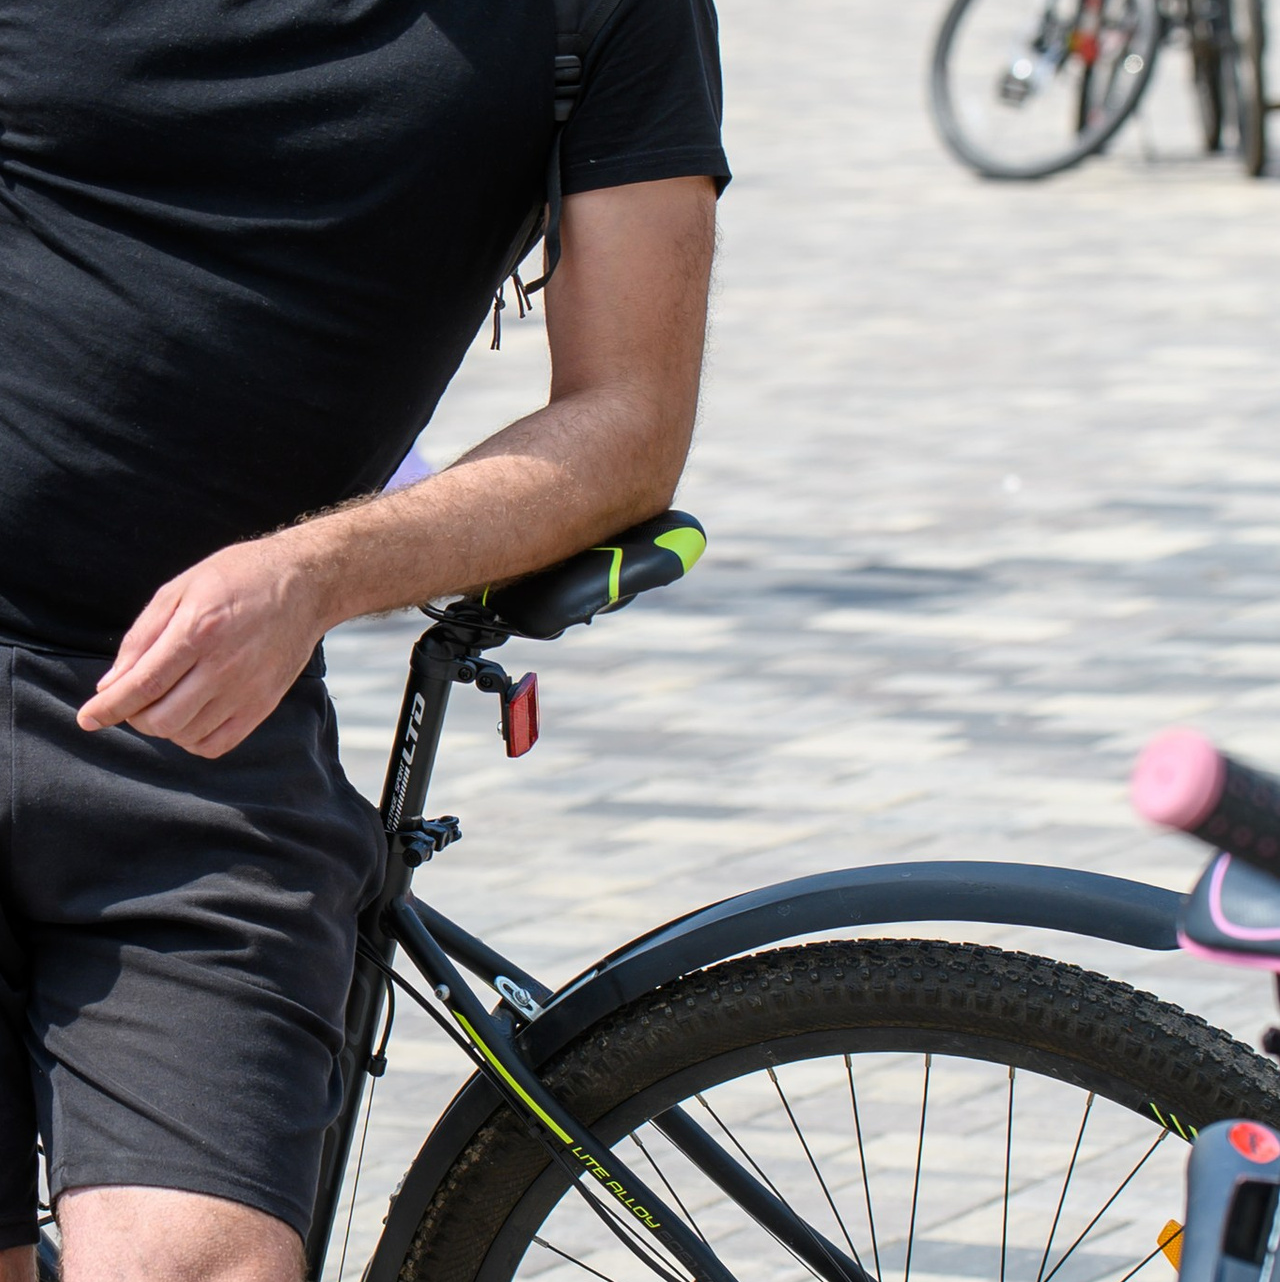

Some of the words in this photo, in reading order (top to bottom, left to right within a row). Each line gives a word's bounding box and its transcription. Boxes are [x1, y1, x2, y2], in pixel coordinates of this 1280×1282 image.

[402, 692, 426, 765] LTD
[572, 1146, 610, 1180] LITE
[606, 1181, 661, 1229] ALLOY
